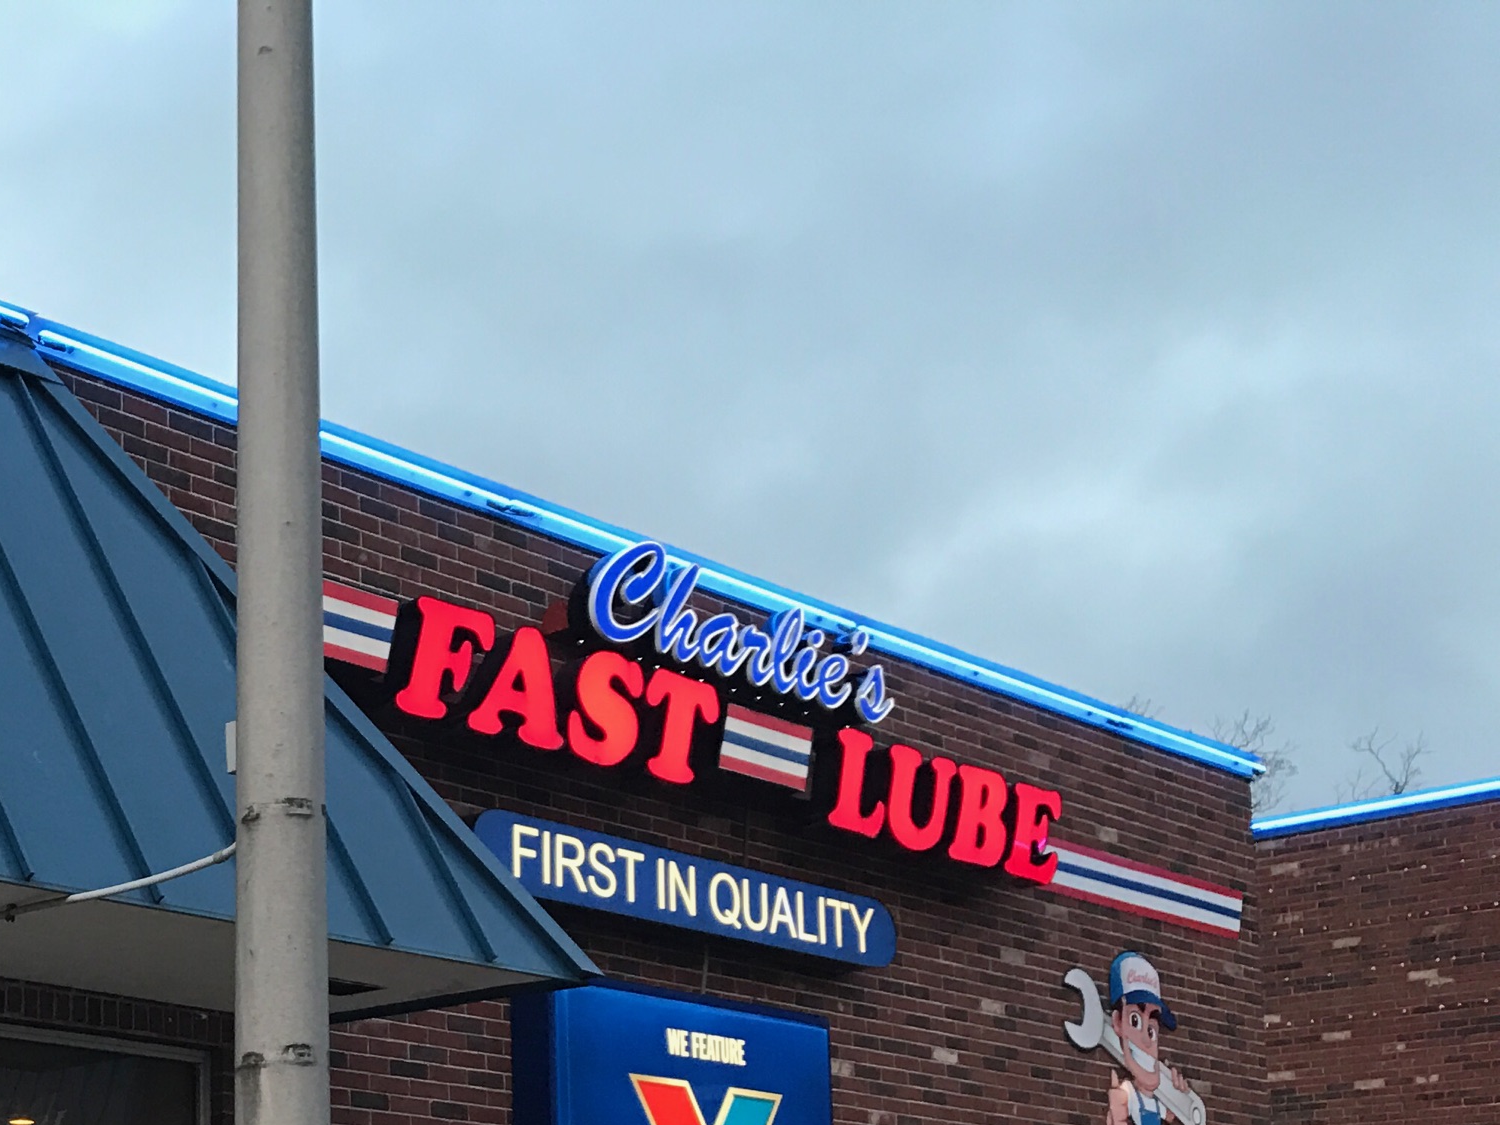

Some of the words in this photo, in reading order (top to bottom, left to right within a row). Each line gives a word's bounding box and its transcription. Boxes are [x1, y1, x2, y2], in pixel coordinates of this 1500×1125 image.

[588, 540, 895, 723] Charlie's
[396, 596, 720, 784] FAST
[828, 727, 1063, 885] LUBE
[511, 823, 645, 903] FIRST
[656, 857, 697, 917] IN
[708, 872, 874, 953] QUALITY
[666, 1028, 690, 1057] WE
[691, 1032, 747, 1066] FEATURE
